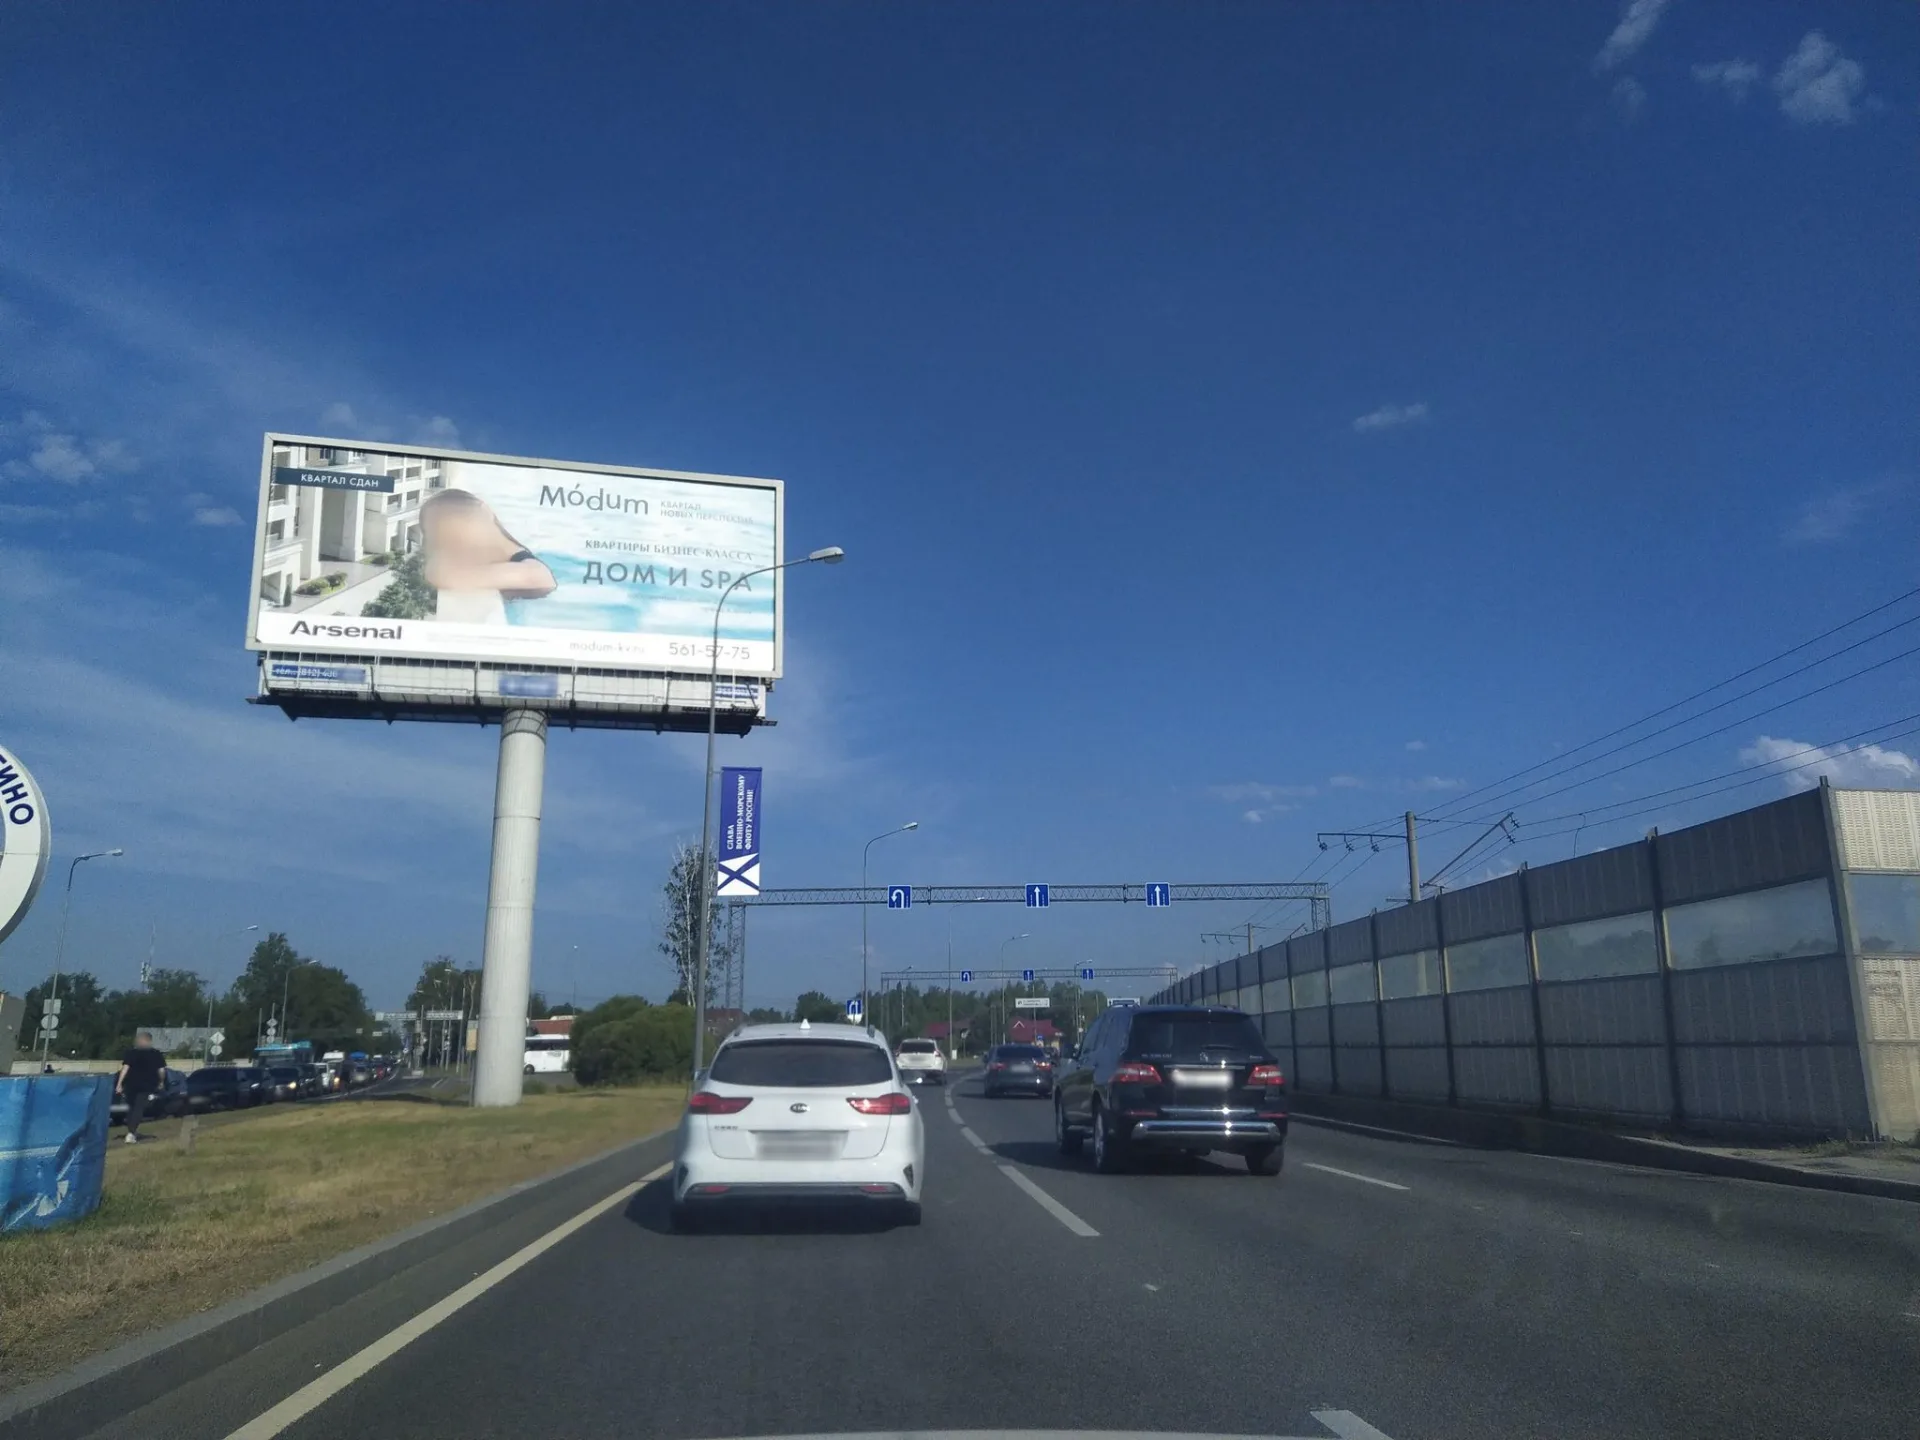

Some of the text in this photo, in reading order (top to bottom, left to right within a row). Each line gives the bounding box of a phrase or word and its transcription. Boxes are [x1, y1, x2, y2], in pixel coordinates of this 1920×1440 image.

[301, 473, 379, 488] КВАРТАЛ СДАН
[539, 483, 649, 515] Módum
[585, 540, 650, 552] КВАРТИРЫ
[583, 561, 752, 592] ДОМ И SPA
[290, 620, 402, 640] Arsenal
[669, 642, 750, 660] 561-57-75
[736, 774, 745, 850] ВОЕННО-МОРСКОМУ
[727, 824, 735, 850] СЛАВА
